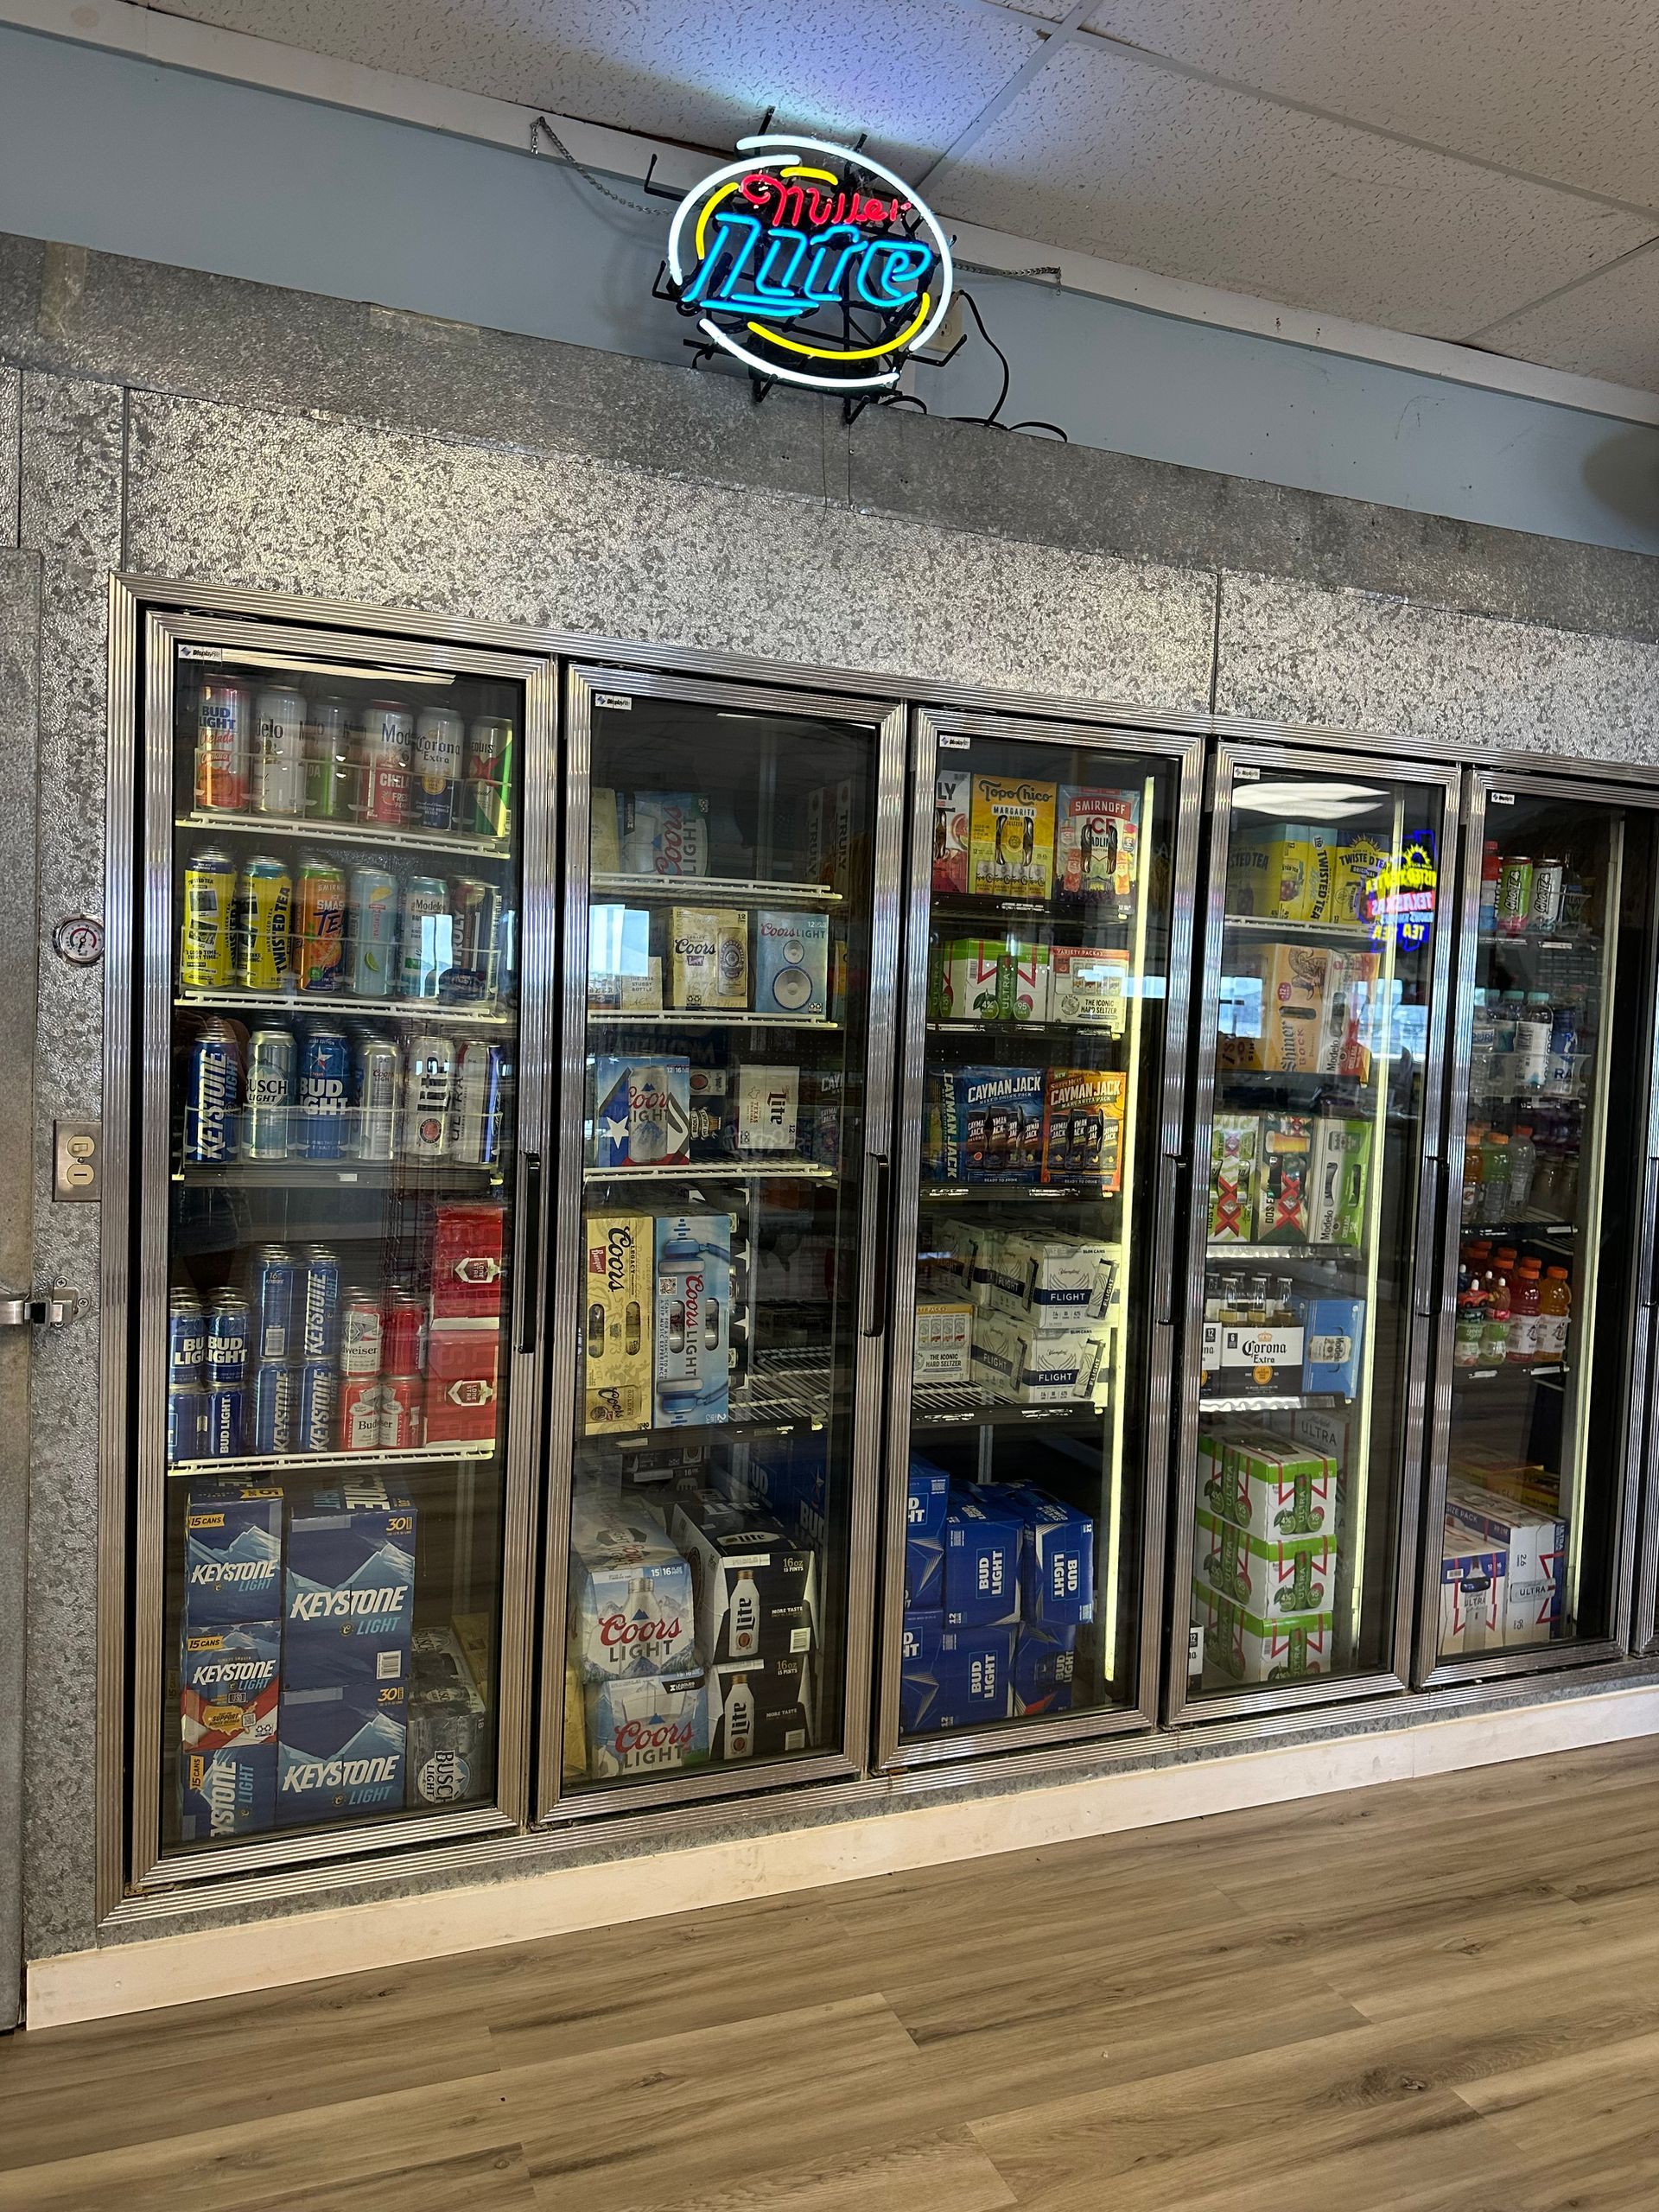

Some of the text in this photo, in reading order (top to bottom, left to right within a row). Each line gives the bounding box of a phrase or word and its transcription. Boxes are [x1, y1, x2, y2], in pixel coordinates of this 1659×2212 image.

[741, 172, 912, 226] Miller
[199, 716, 237, 730] LIGHT
[202, 706, 231, 718] BUD
[416, 734, 461, 755] Corona
[423, 753, 450, 765] Extra
[979, 779, 1053, 806] Topo Chico
[994, 805, 1035, 817] MARGARITA
[1075, 800, 1126, 815] SMIRNOFF
[655, 804, 683, 875] Coors
[683, 810, 697, 876] LIGHT
[1253, 851, 1270, 871] TEA
[1338, 852, 1375, 866] TWISTED
[1310, 849, 1329, 920] TWISTED TEA
[272, 886, 290, 975] TWISTED TEA
[760, 922, 827, 939] Coors LIGHT
[675, 938, 717, 954] Coors
[1056, 948, 1081, 957] VARIETY
[1001, 971, 1011, 1010] ULTRA
[982, 1001, 994, 1009] 4%
[1080, 1006, 1117, 1015] HARD SELTZER
[1096, 1000, 1115, 1008] ICONIC
[1281, 1020, 1297, 1072] Shiner
[1297, 1028, 1306, 1066] BOCK
[1326, 1039, 1338, 1071] Modelo
[225, 1056, 238, 1099] LIGHT
[245, 1079, 288, 1095] BUSCH
[968, 1076, 1041, 1103] CAYMAN JACK
[197, 1049, 226, 1160] KEYSTONE
[999, 1093, 1018, 1102] DRINK
[1050, 1080, 1121, 1106] CAYMAN JACK
[1061, 1098, 1096, 1109] MARGARITA
[766, 1092, 787, 1125] Lite
[788, 1124, 796, 1134] 12
[944, 1072, 957, 1179] CAYMAN JACK
[1265, 1204, 1275, 1224] DOS
[1321, 1210, 1334, 1241] Modelo
[607, 1225, 631, 1294] Coors
[998, 1276, 1020, 1293] FLIGHT
[1103, 1278, 1115, 1306] FLIGHT
[1051, 1292, 1086, 1302] FLIGHT
[304, 1270, 327, 1355] KEYSTONE
[685, 1274, 705, 1376] Coors LIGHT
[1207, 1328, 1215, 1337] 12
[207, 1337, 243, 1351] BUD
[1242, 1339, 1287, 1358] Corona
[983, 1352, 1007, 1371] FLIGHT
[1253, 1354, 1276, 1363] Extra
[1039, 1373, 1072, 1382] FLIGHT
[1089, 1357, 1102, 1386] FLIGHT
[273, 1371, 289, 1453] KEYSTONE
[309, 1370, 332, 1452] KEYSTONE
[220, 1397, 231, 1453] BUD LIGHT
[1301, 1421, 1338, 1446] ULTRA
[1225, 1465, 1234, 1508] ULTRA
[191, 1516, 223, 1526] 15 CANS
[386, 1516, 407, 1531] 30
[1281, 1516, 1292, 1524] 4%
[1310, 1513, 1319, 1522] 95
[1460, 1509, 1478, 1523] PACK
[191, 1560, 278, 1585] KEYSTONE
[651, 1567, 671, 1577] 15 16
[978, 1556, 989, 1591] BUD
[991, 1550, 1003, 1596] LIGHT
[1053, 1553, 1065, 1599] LIGHT
[1067, 1558, 1078, 1592] BUD
[238, 1578, 274, 1592] LIGHT
[1520, 1585, 1546, 1598] ULTRA
[289, 1586, 408, 1621] KEYSTONE
[1281, 1593, 1292, 1602] 4%
[357, 1617, 401, 1636] LIGHT
[736, 1597, 756, 1632] Lite
[949, 1612, 957, 1624] 12
[598, 1614, 683, 1647] Coors
[189, 1640, 200, 1649] 15
[609, 1639, 674, 1663] LIGHT
[192, 1659, 276, 1686] KEYSTONE
[971, 1660, 982, 1694] BUD
[984, 1654, 995, 1700] LIGHT
[1055, 1654, 1065, 1682] BUD
[1064, 1649, 1075, 1683] LIGHT
[238, 1678, 270, 1691] LIGHT
[377, 1688, 398, 1702] 30
[731, 1701, 752, 1737] Lite
[941, 1715, 949, 1727] 12
[613, 1720, 695, 1753] Coors
[624, 1745, 684, 1769] LIGHT
[192, 1777, 201, 1787] 15
[238, 1764, 254, 1803] LIGHT
[282, 1754, 400, 1793] KEYSTONE
[348, 1785, 392, 1806] LIGHT
